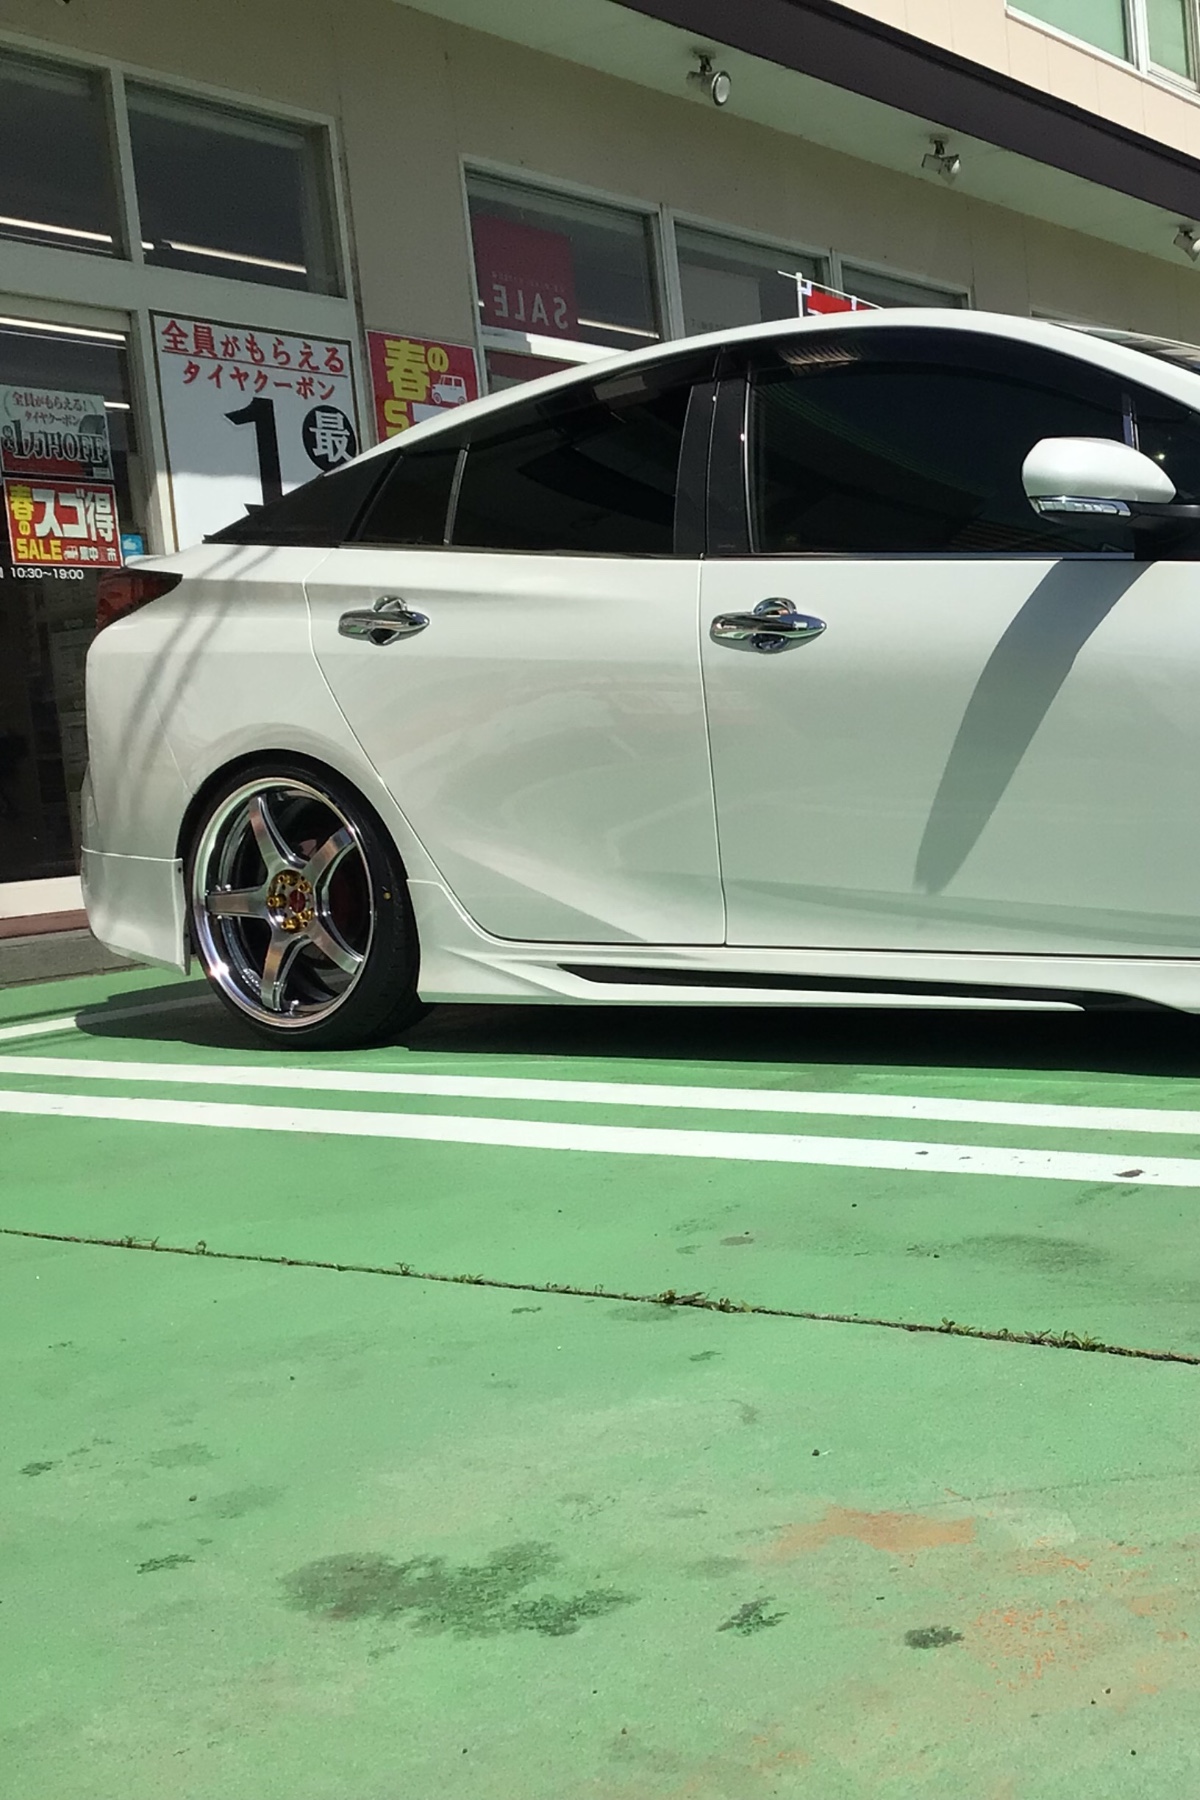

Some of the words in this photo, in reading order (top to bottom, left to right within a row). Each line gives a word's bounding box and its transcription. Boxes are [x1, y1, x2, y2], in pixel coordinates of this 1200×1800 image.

[161, 319, 345, 374] 全員がもらえる
[384, 339, 450, 401] 春の
[183, 360, 336, 400] タイヤクーポン
[31, 488, 115, 542] スゴ得
[16, 538, 63, 561] SALE
